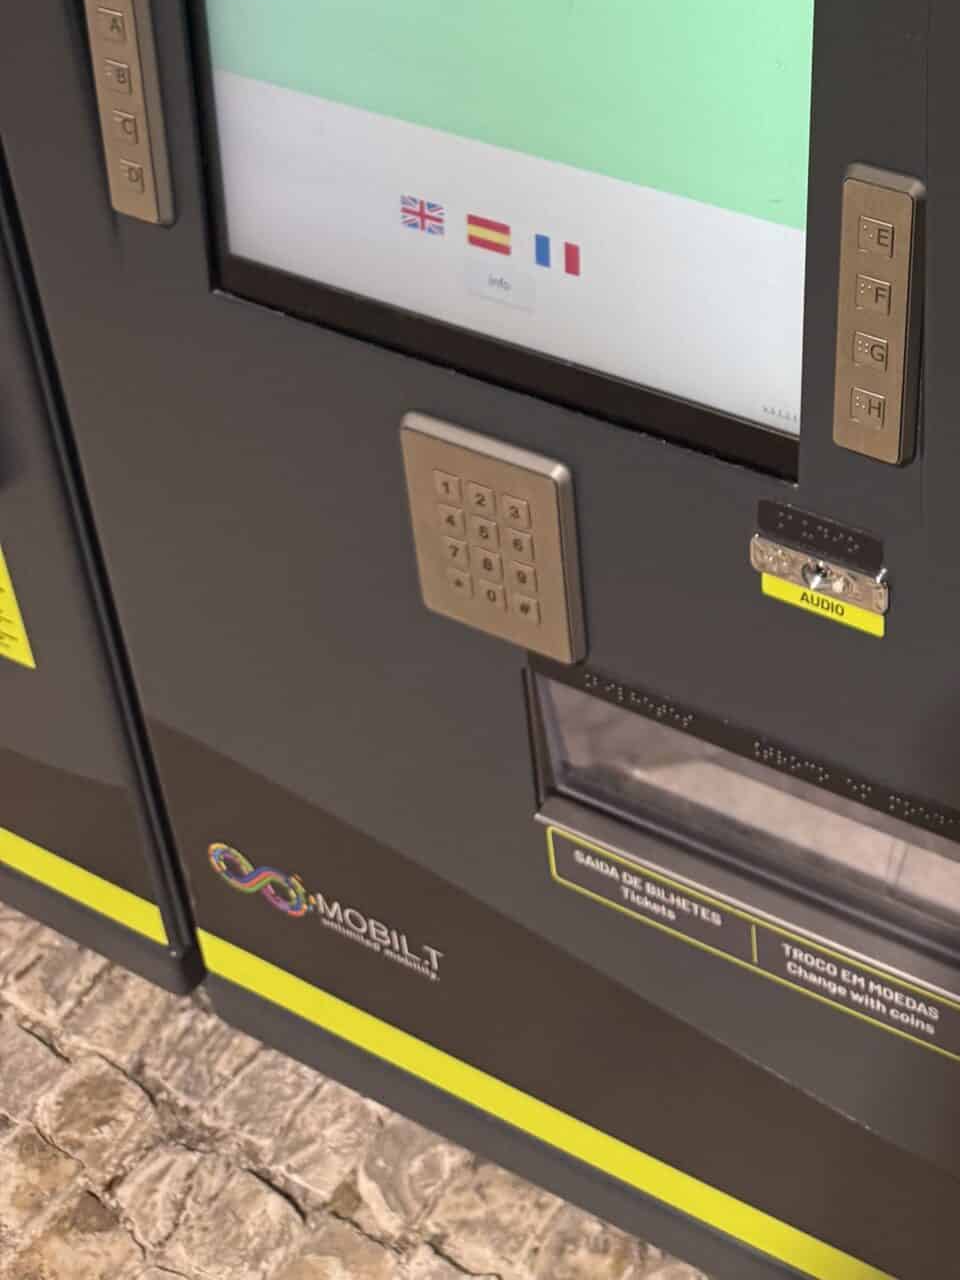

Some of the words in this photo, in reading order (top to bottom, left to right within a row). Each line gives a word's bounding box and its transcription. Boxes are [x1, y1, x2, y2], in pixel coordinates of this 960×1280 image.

[876, 228, 889, 248] E
[874, 286, 887, 305] F
[870, 343, 885, 363] G
[868, 397, 882, 418] H
[800, 591, 845, 616] AUDIO
[620, 885, 676, 921] Tickets
[621, 871, 643, 890] DE
[645, 881, 722, 927] BILHETES
[781, 942, 838, 977] TROCO
[840, 968, 865, 989] EM
[868, 980, 939, 1021] MOEDAS
[786, 961, 848, 997] Change
[850, 991, 888, 1014] with
[889, 1008, 935, 1035] coins
